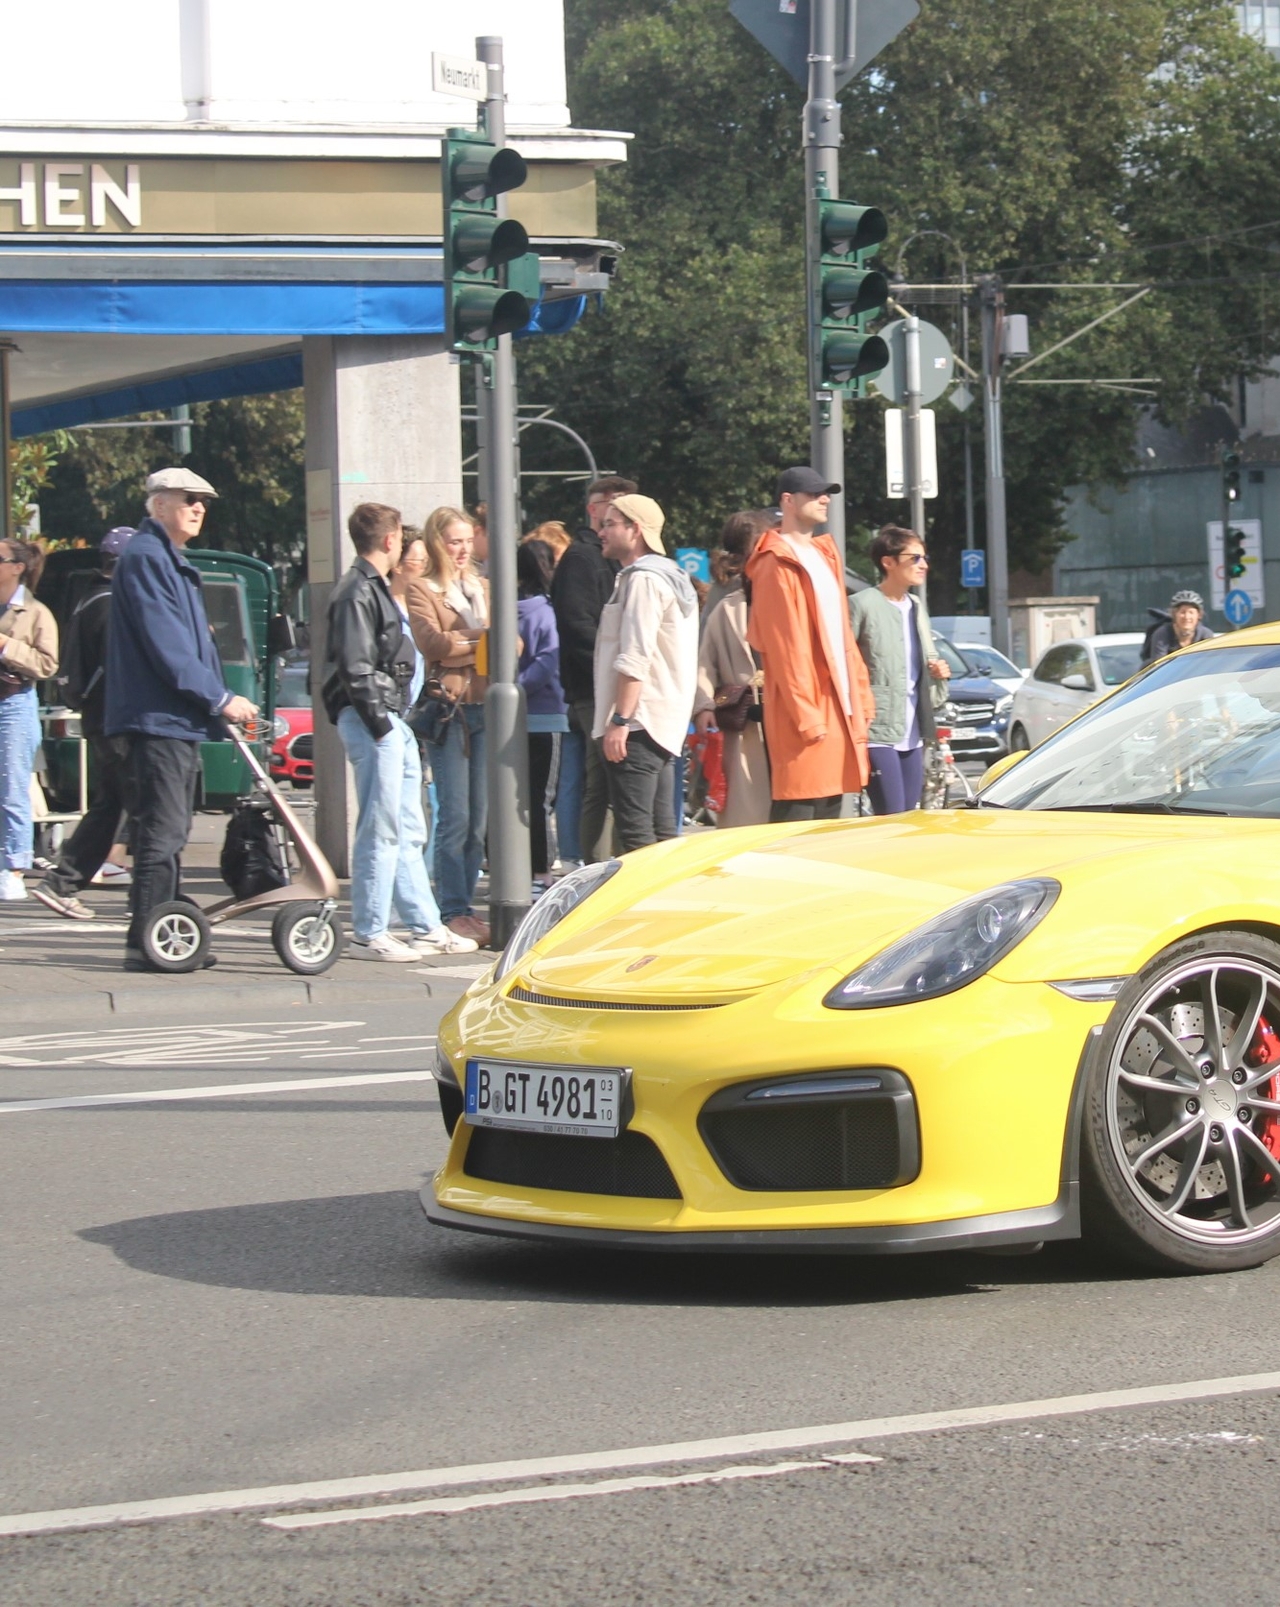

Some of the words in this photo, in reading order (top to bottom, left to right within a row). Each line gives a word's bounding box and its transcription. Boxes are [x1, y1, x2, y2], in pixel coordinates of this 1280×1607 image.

[441, 61, 480, 90] Neumarkt
[0, 163, 142, 226] HEN
[968, 559, 979, 573] P
[601, 1079, 613, 1091] 03
[469, 1094, 475, 1106] D
[479, 1069, 491, 1109] B
[505, 1072, 530, 1114] GT
[537, 1075, 597, 1120] 4981
[601, 1109, 612, 1121] 10
